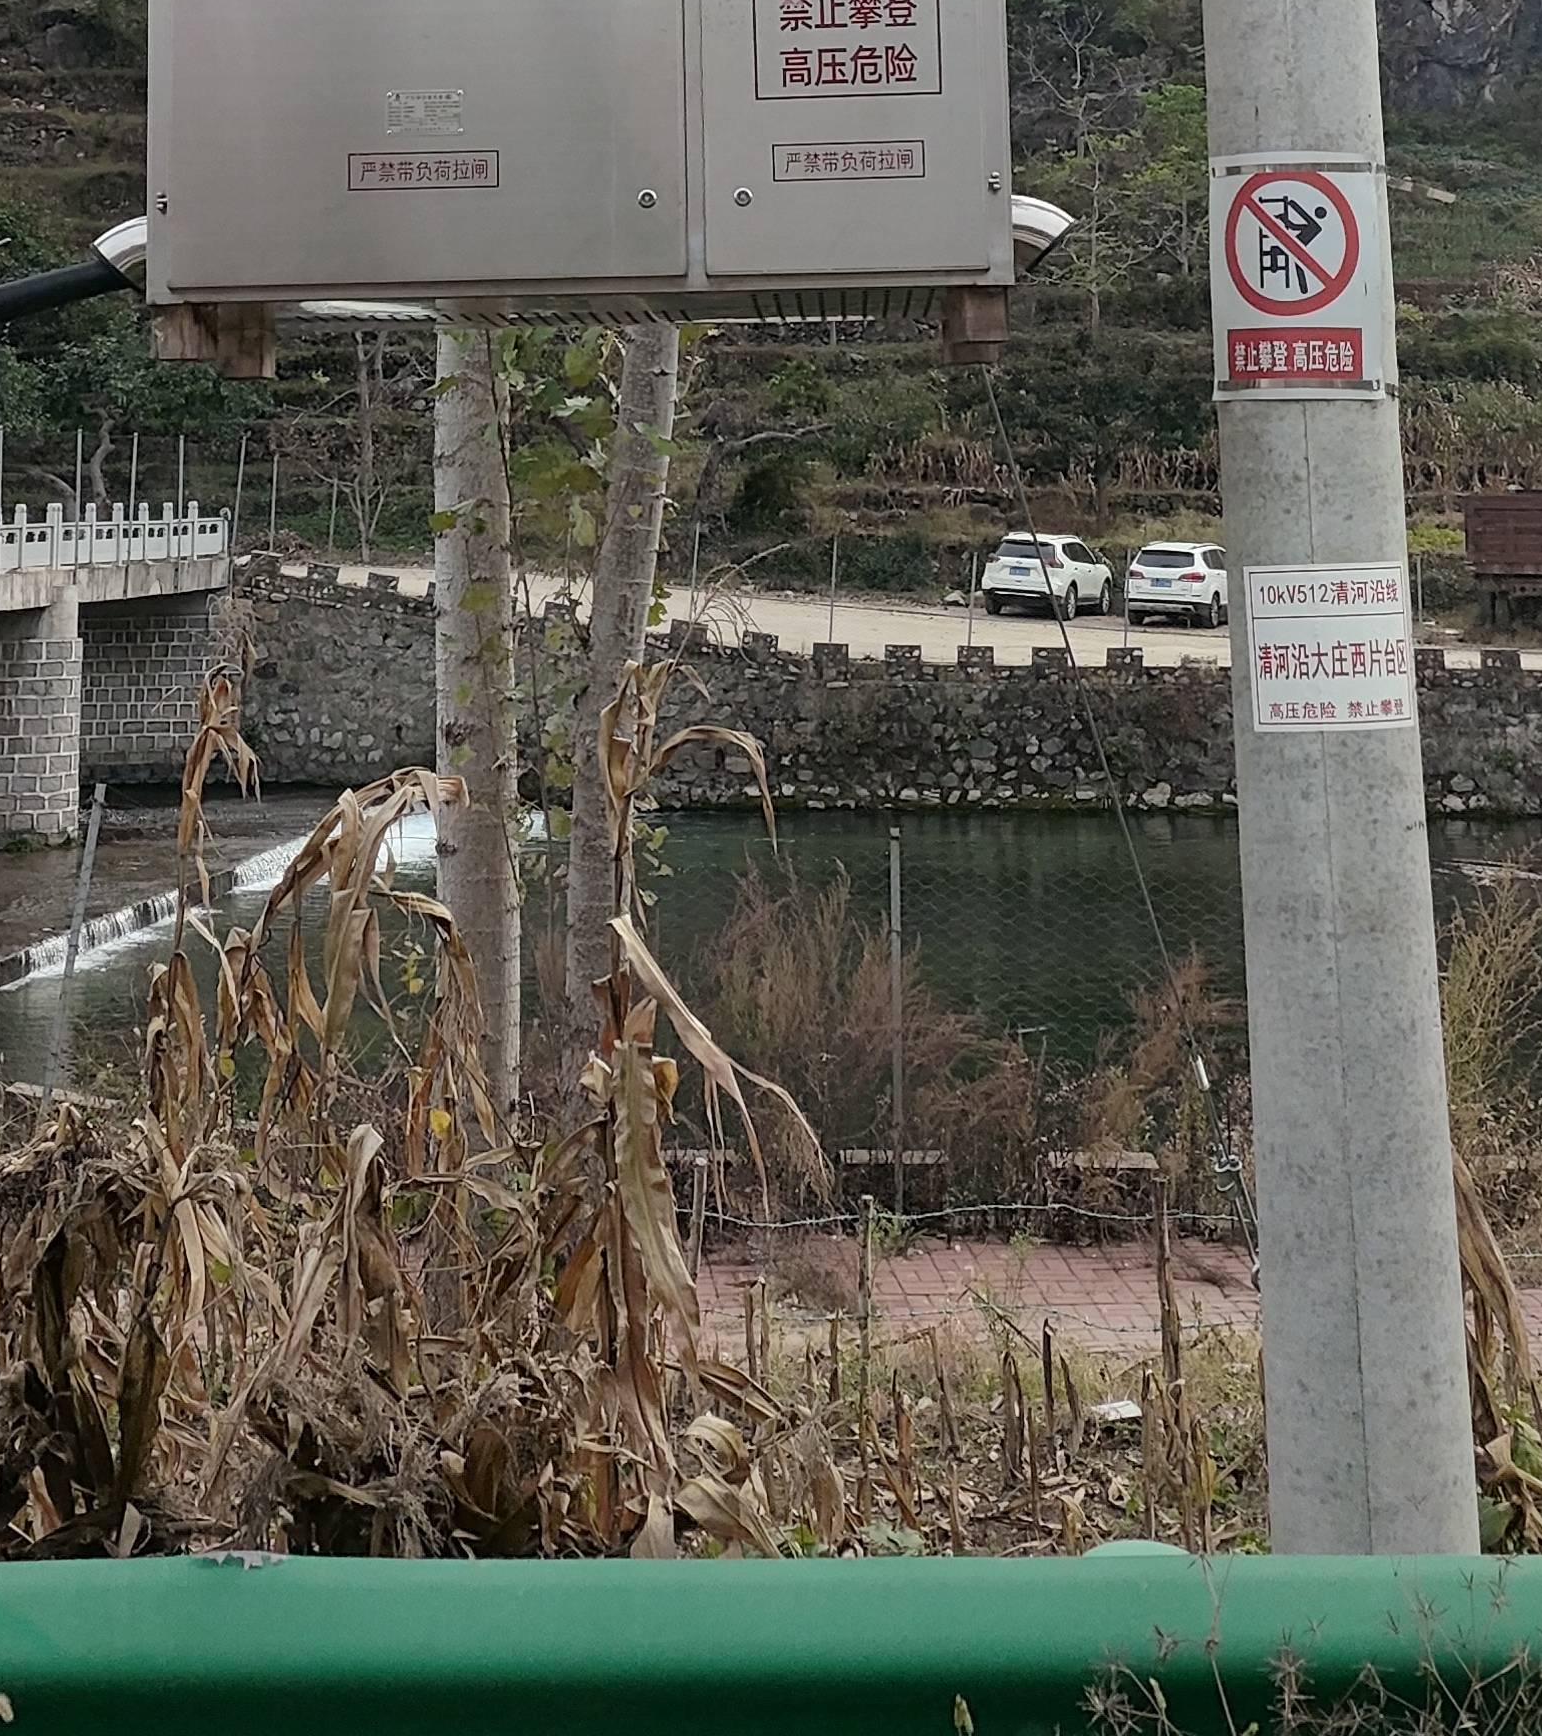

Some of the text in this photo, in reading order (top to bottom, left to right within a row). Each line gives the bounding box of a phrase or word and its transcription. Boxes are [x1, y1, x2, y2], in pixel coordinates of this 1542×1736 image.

[779, 44, 918, 88] 高压危险
[359, 157, 489, 184] 严禁带负荷拉闸
[784, 149, 915, 175] 严禁带负荷拉闸
[1234, 340, 1354, 373] 禁止攀登 高压危险
[1259, 578, 1399, 606] 10kV512清河沿线
[1258, 638, 1406, 680] 清河沿大庄西片台区
[1269, 698, 1404, 719] 高压危险 禁止攀登
